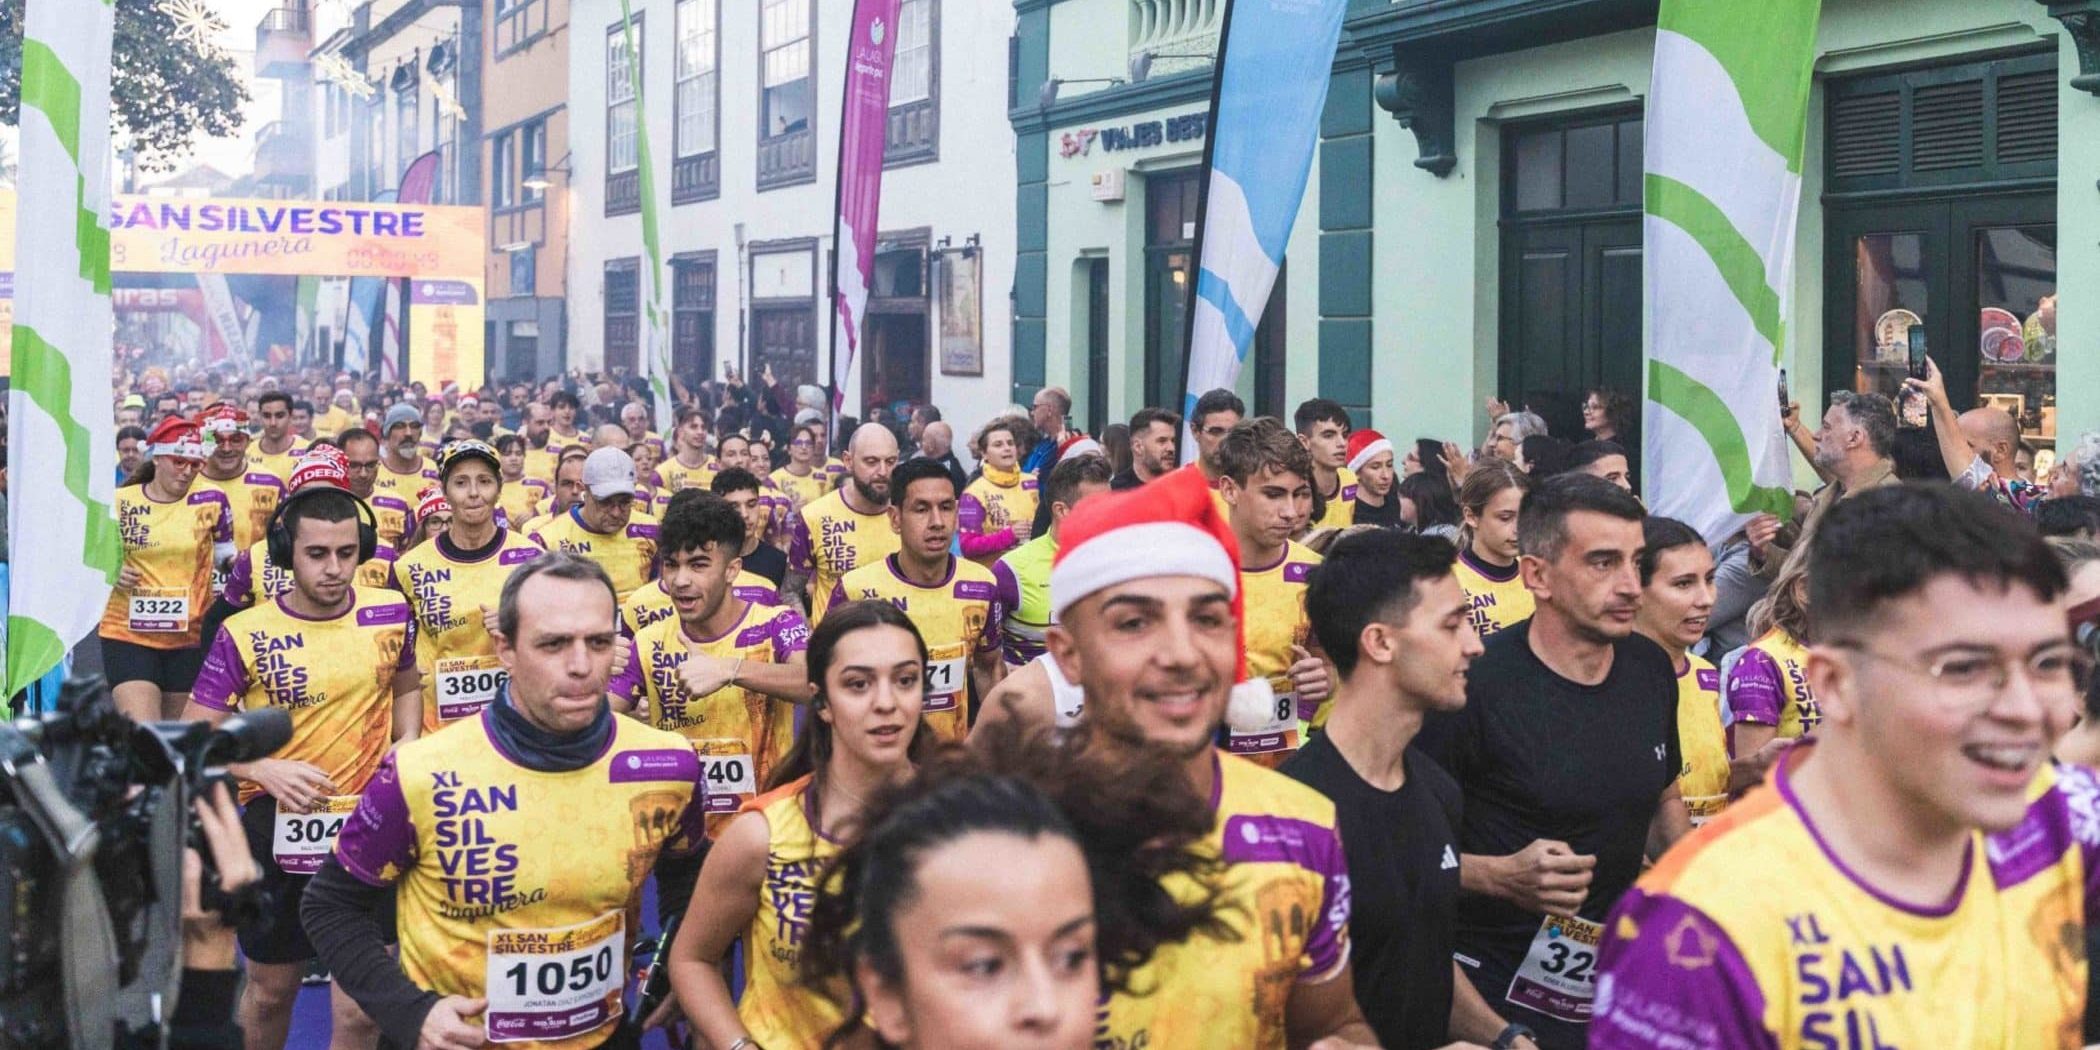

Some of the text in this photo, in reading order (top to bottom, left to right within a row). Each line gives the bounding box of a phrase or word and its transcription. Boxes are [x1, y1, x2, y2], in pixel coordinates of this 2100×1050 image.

[1101, 121, 1163, 152] VIAJES
[111, 202, 425, 238] SAN SILVESTRE
[160, 235, 311, 269] Lagunera
[121, 506, 151, 516] SAN
[120, 517, 141, 527] SIL
[120, 525, 150, 537] VES
[822, 521, 856, 536] SAN
[822, 536, 847, 548] SIL
[824, 546, 857, 559] VES
[408, 564, 424, 574] XL
[826, 559, 857, 571] TRE
[264, 569, 289, 580] SIL
[411, 569, 451, 587] SAN
[413, 586, 440, 599] SIL
[861, 588, 878, 599] XL
[135, 601, 182, 614] 3322
[419, 596, 452, 613] VES
[633, 604, 648, 615] XL
[420, 611, 450, 628] TRE
[637, 606, 674, 629] SAN
[249, 630, 269, 643] XL
[253, 632, 304, 657] SAN
[652, 640, 664, 651] XL
[256, 653, 292, 673] SIL
[652, 652, 688, 669] SAN
[259, 667, 308, 688] VES
[446, 671, 508, 695] 3806
[264, 685, 307, 705] TRE
[431, 771, 463, 789] XL
[433, 784, 517, 818] SAN
[435, 818, 496, 847] SIL
[436, 844, 519, 876] VES
[440, 874, 516, 904] TRE
[439, 887, 548, 922] Lagunera
[1785, 913, 1829, 943] XL
[496, 933, 548, 943] XL SAN
[495, 941, 575, 954] SILVESTRE
[506, 945, 612, 996] 1050
[1540, 942, 1601, 984] 32
[1797, 944, 1912, 1004] SAN
[1801, 1009, 1900, 1050] SIL
